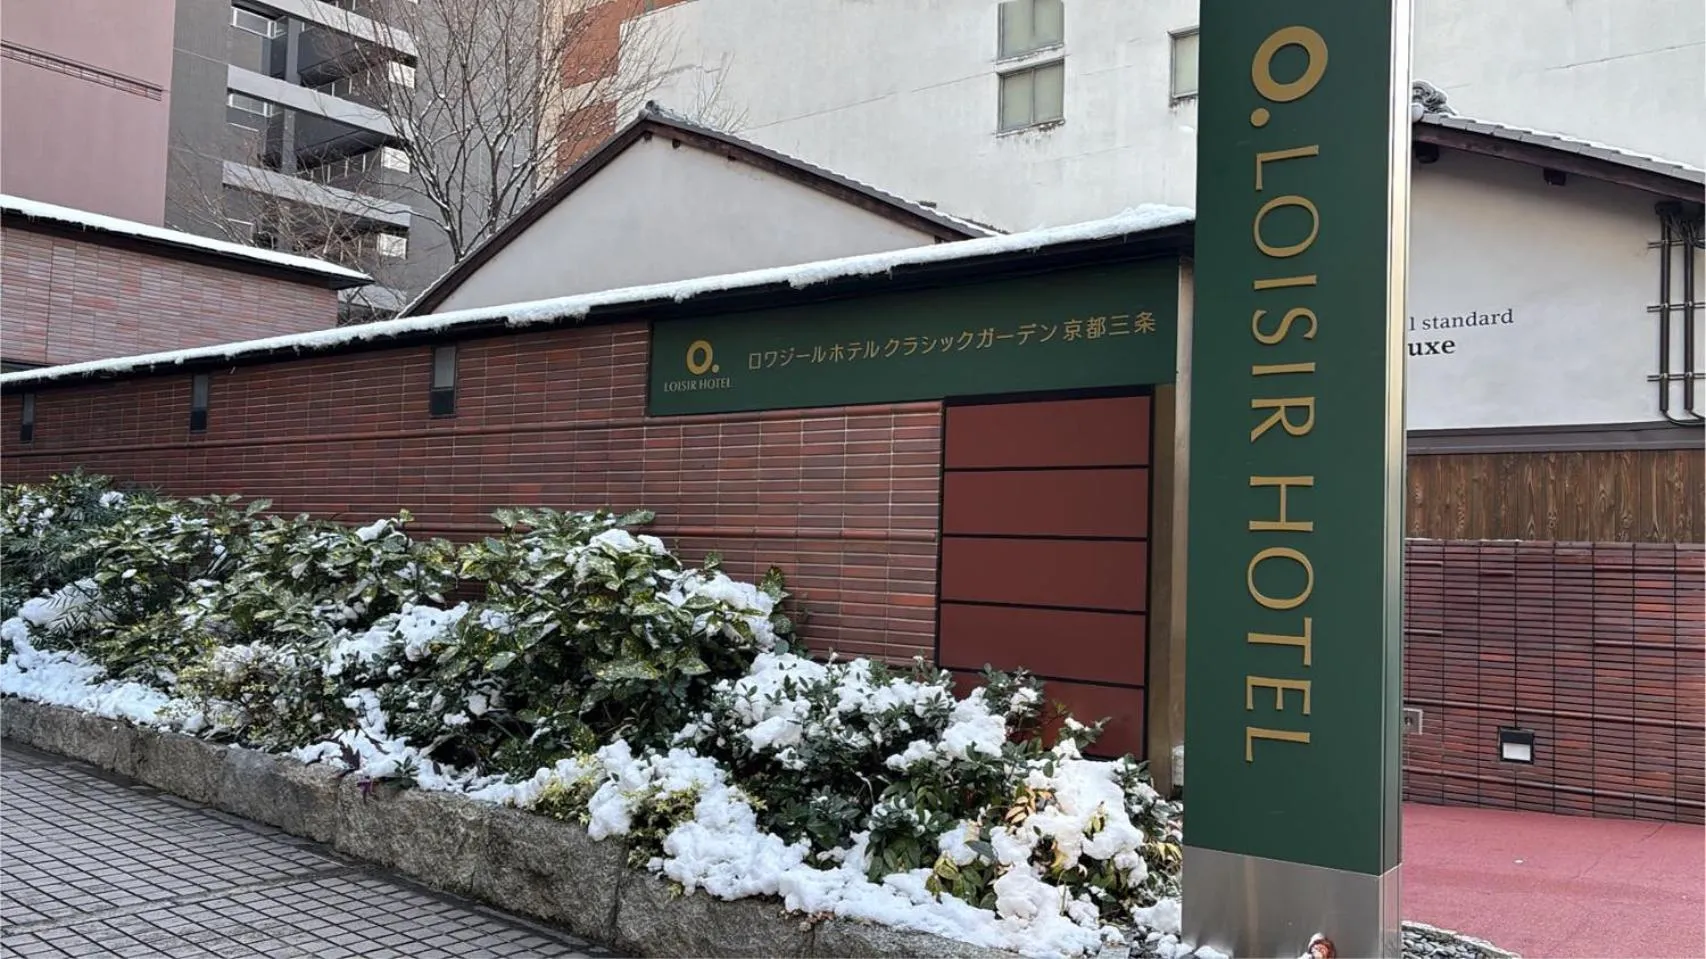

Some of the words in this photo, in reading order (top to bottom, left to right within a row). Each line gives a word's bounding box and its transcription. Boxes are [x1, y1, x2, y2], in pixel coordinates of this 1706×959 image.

[1250, 144, 1320, 443] LOISIR
[1422, 308, 1514, 331] standard
[663, 380, 697, 392] LOISIR
[699, 377, 734, 390] HOTEL
[1245, 475, 1315, 764] HOTEL
